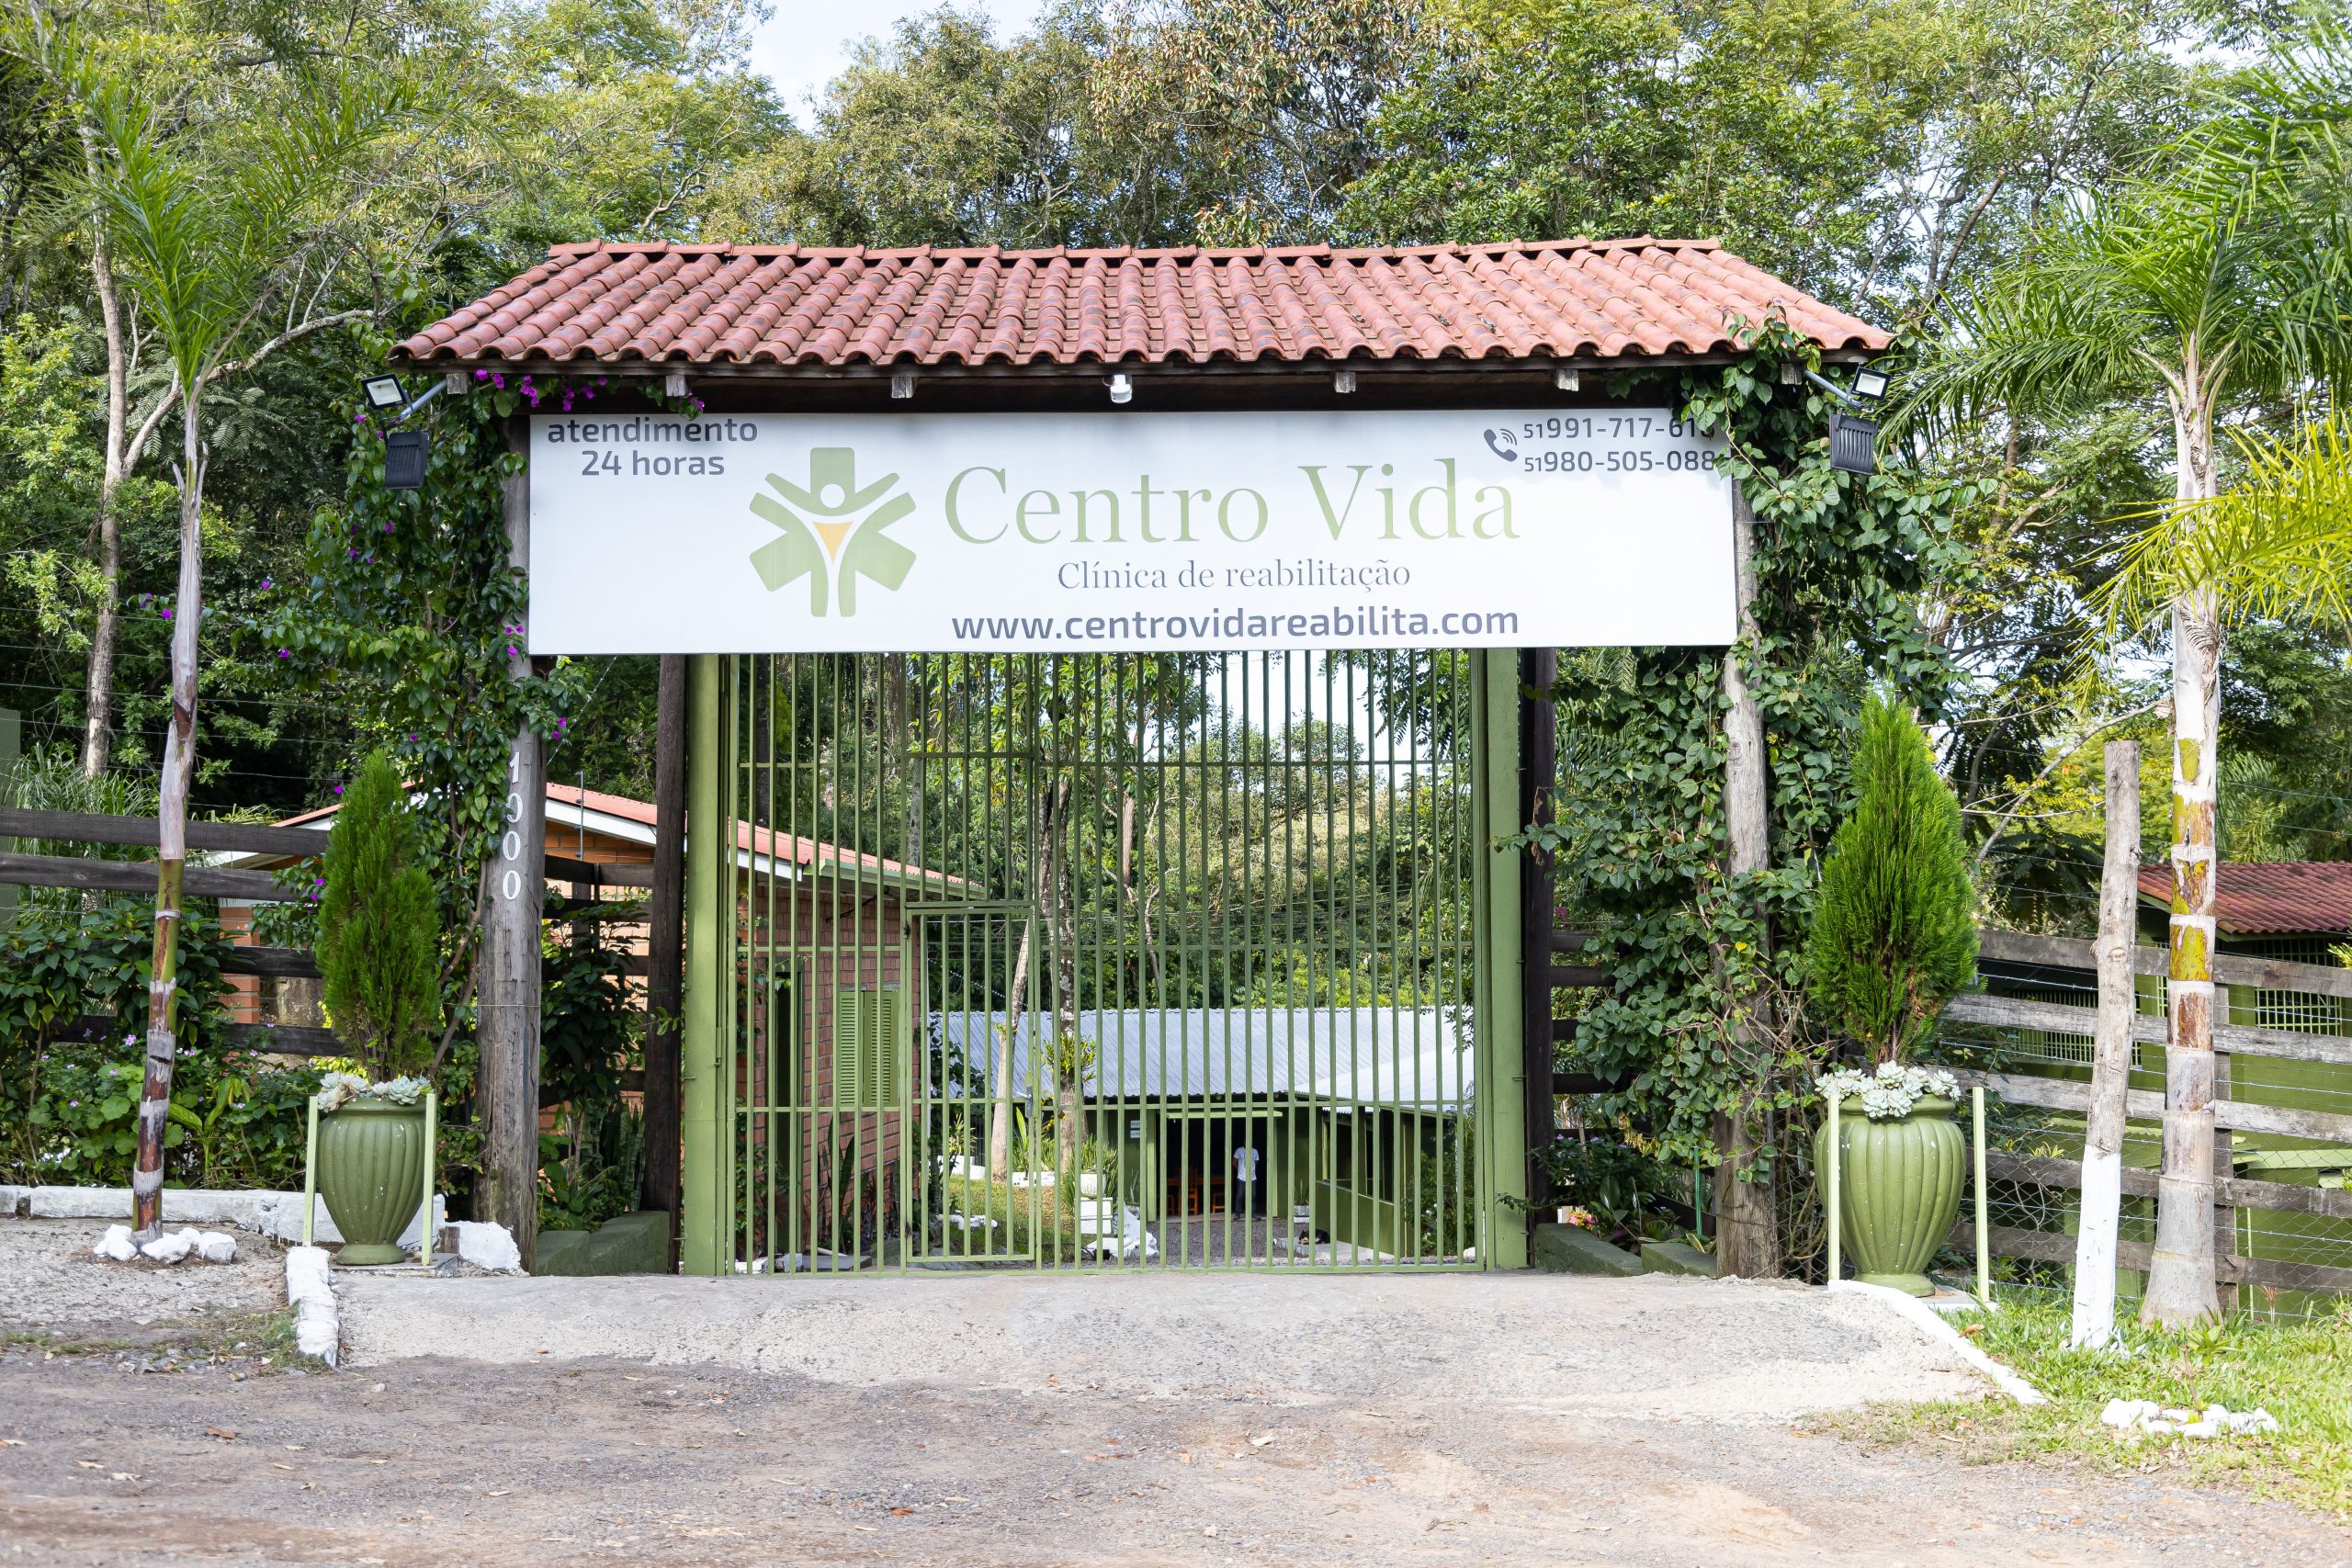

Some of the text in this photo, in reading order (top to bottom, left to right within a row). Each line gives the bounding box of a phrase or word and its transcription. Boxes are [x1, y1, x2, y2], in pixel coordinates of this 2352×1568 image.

[547, 416, 758, 443] atendimento
[582, 450, 725, 476] 24 horas
[944, 457, 1521, 545] Centro Vida
[1057, 558, 1410, 592] Clínica de reabilitação
[951, 605, 1519, 640] www.centrovidareabilita.com
